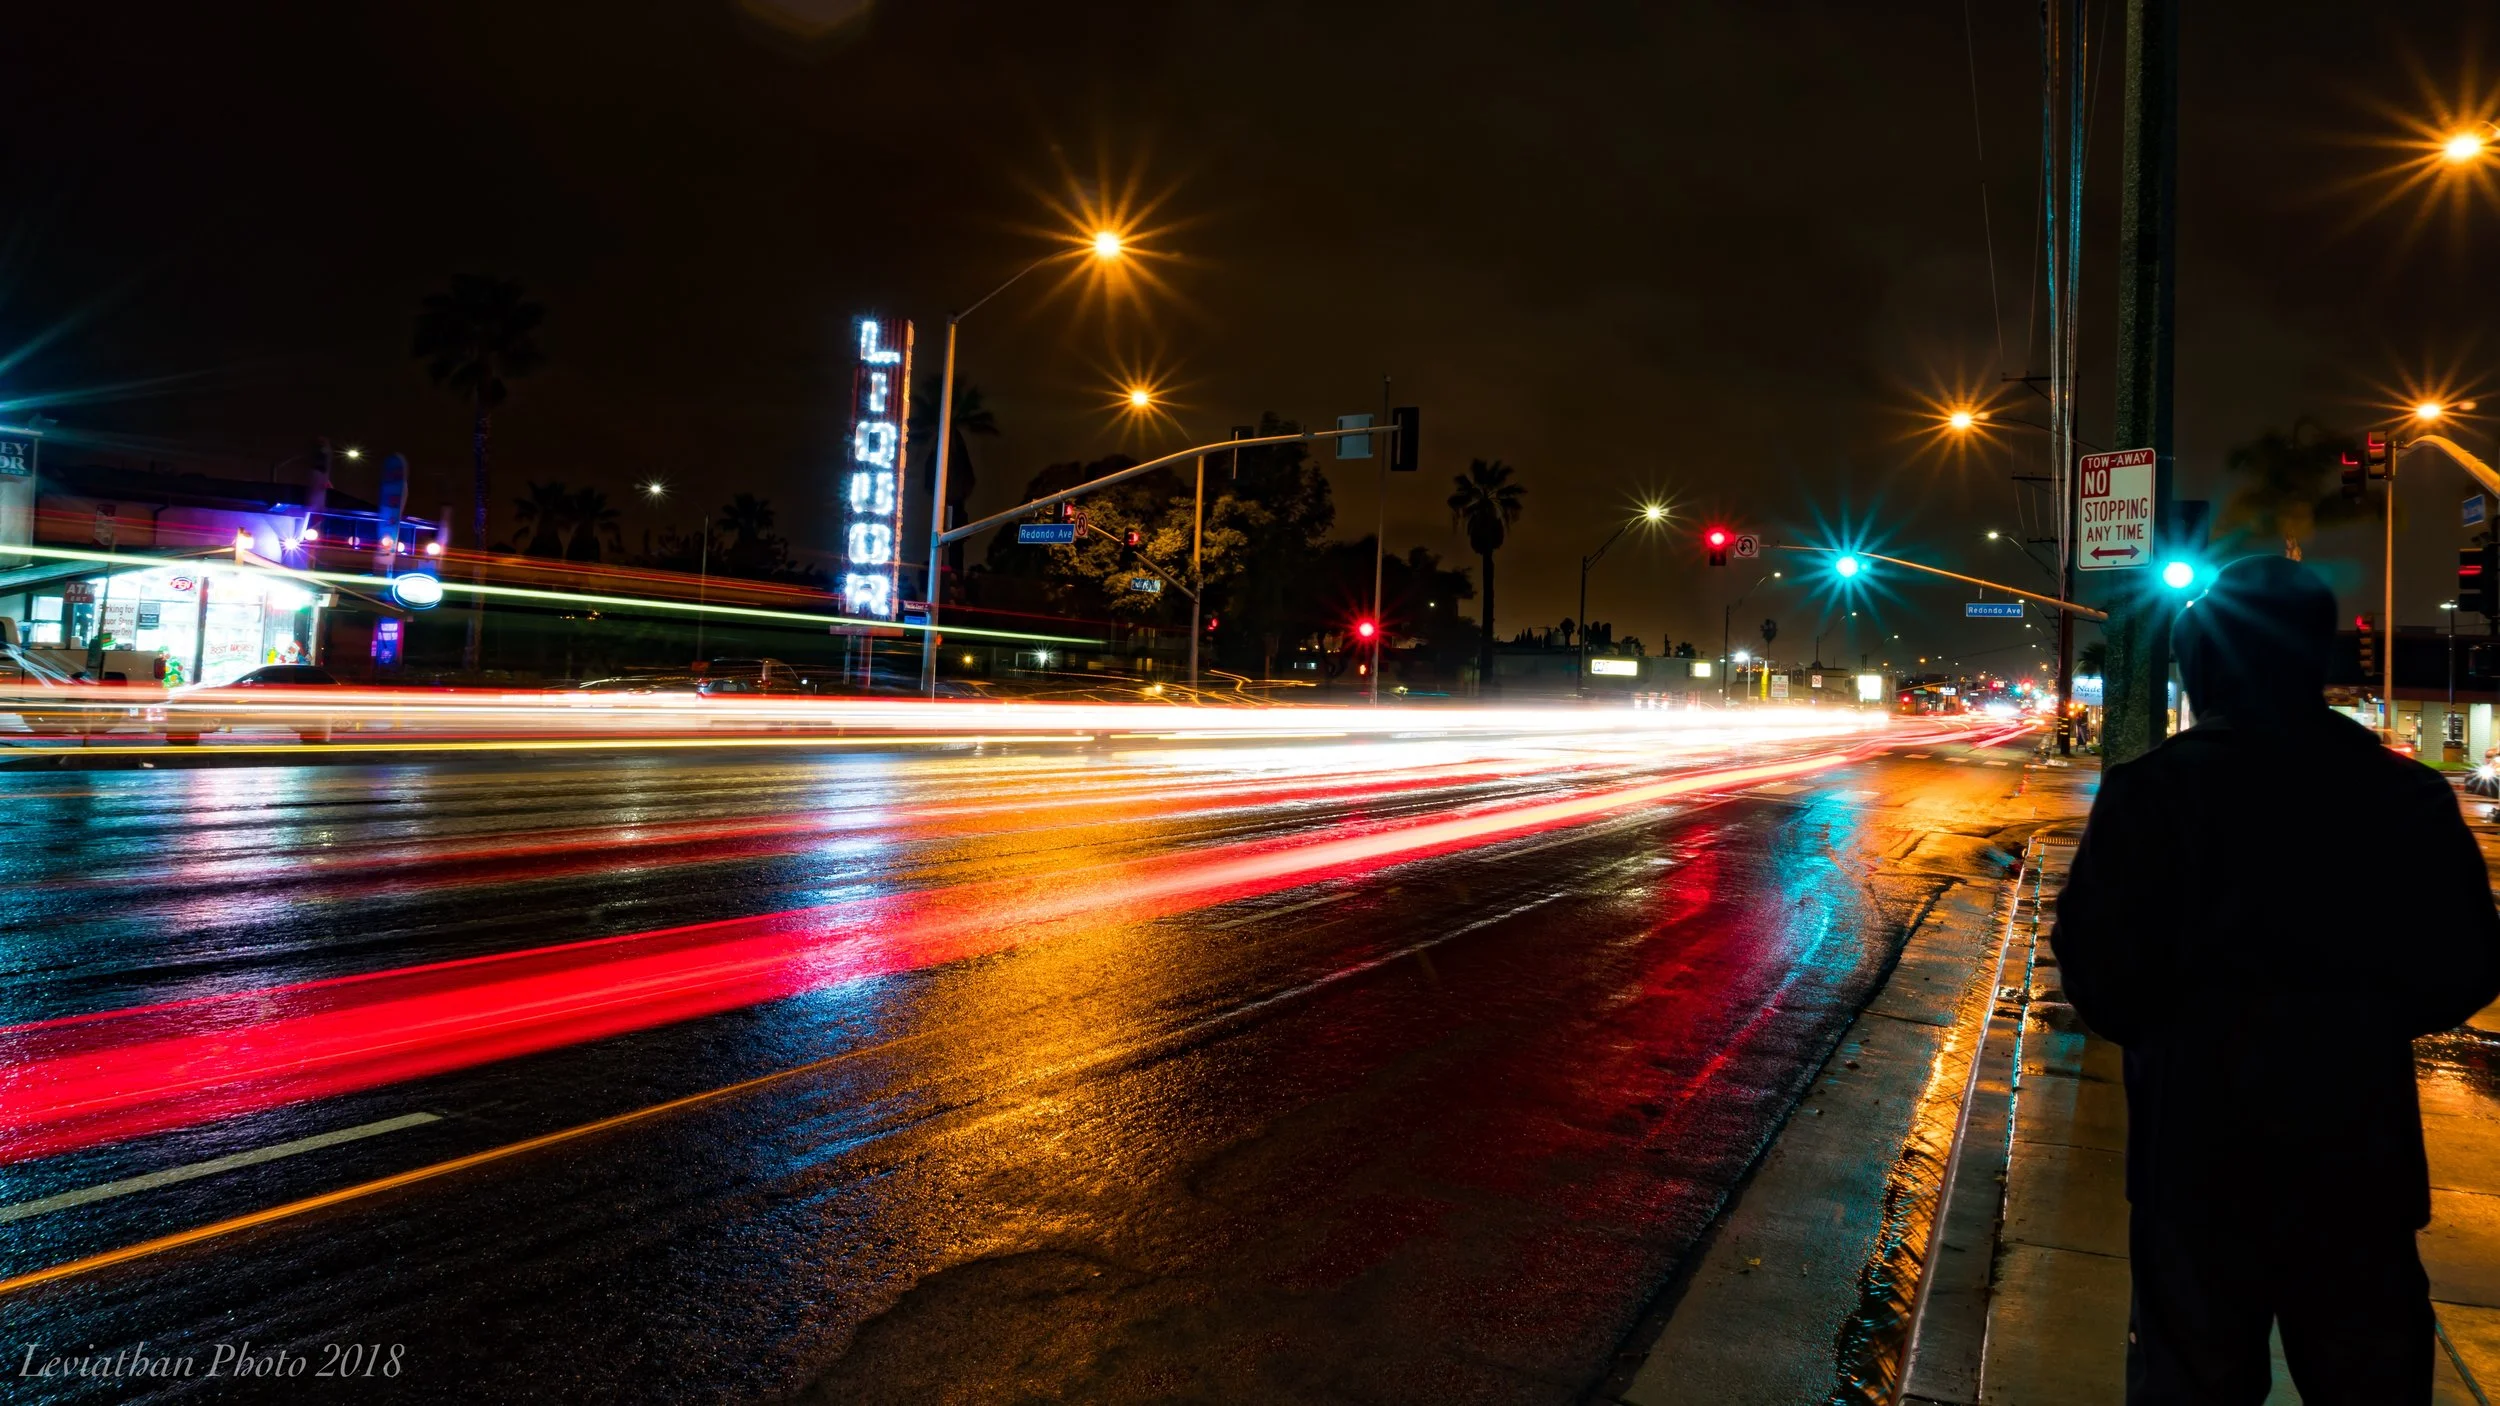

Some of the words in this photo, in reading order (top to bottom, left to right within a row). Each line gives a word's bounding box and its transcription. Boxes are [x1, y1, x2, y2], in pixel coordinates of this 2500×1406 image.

[846, 320, 900, 615] LIQUOR
[2087, 451, 2148, 469] TOW-AWAY
[2084, 469, 2107, 495] NO
[2084, 497, 2148, 523] STOPPING
[1020, 529, 1054, 539] Redondo
[1058, 529, 1072, 539] Ave
[2086, 526, 2111, 542] ANY
[2116, 524, 2144, 540] TIME
[1968, 606, 2002, 614] Redondo
